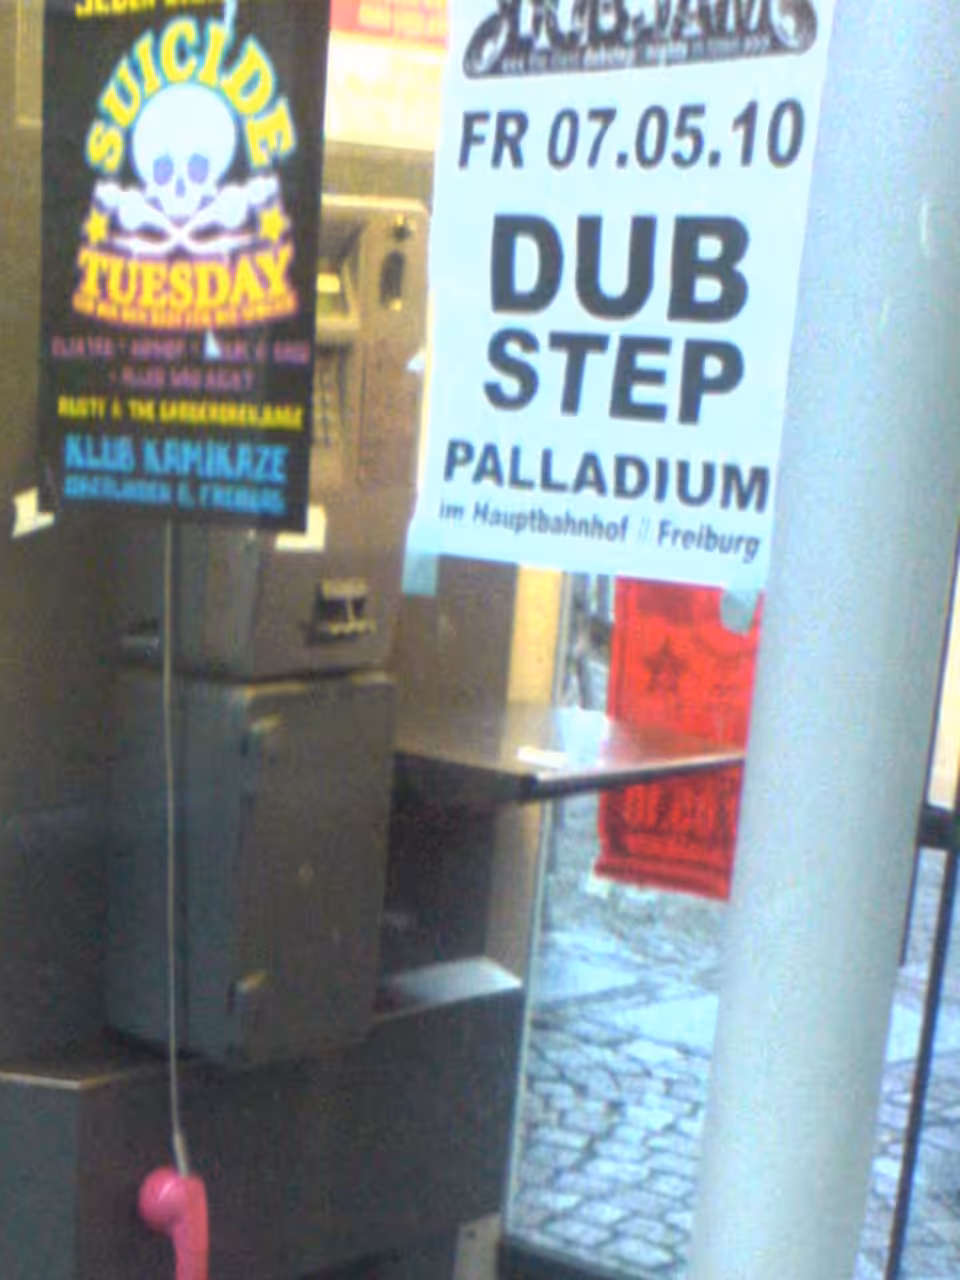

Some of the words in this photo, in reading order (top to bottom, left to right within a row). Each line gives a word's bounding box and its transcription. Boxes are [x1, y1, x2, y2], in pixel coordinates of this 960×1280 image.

[86, 17, 296, 173] SUICIDE
[458, 109, 529, 170] FR
[547, 98, 805, 171] 07.05.10
[77, 243, 295, 309] TUESDAY
[490, 213, 751, 323] DUB
[483, 327, 744, 425] STEP
[64, 434, 135, 474] KLUB
[142, 438, 288, 485] KAMIKAZE
[443, 438, 770, 513] PALLADIUM
[439, 497, 464, 521] im
[472, 500, 629, 543] Hauptbahnhof
[657, 519, 761, 563] Freiburg
